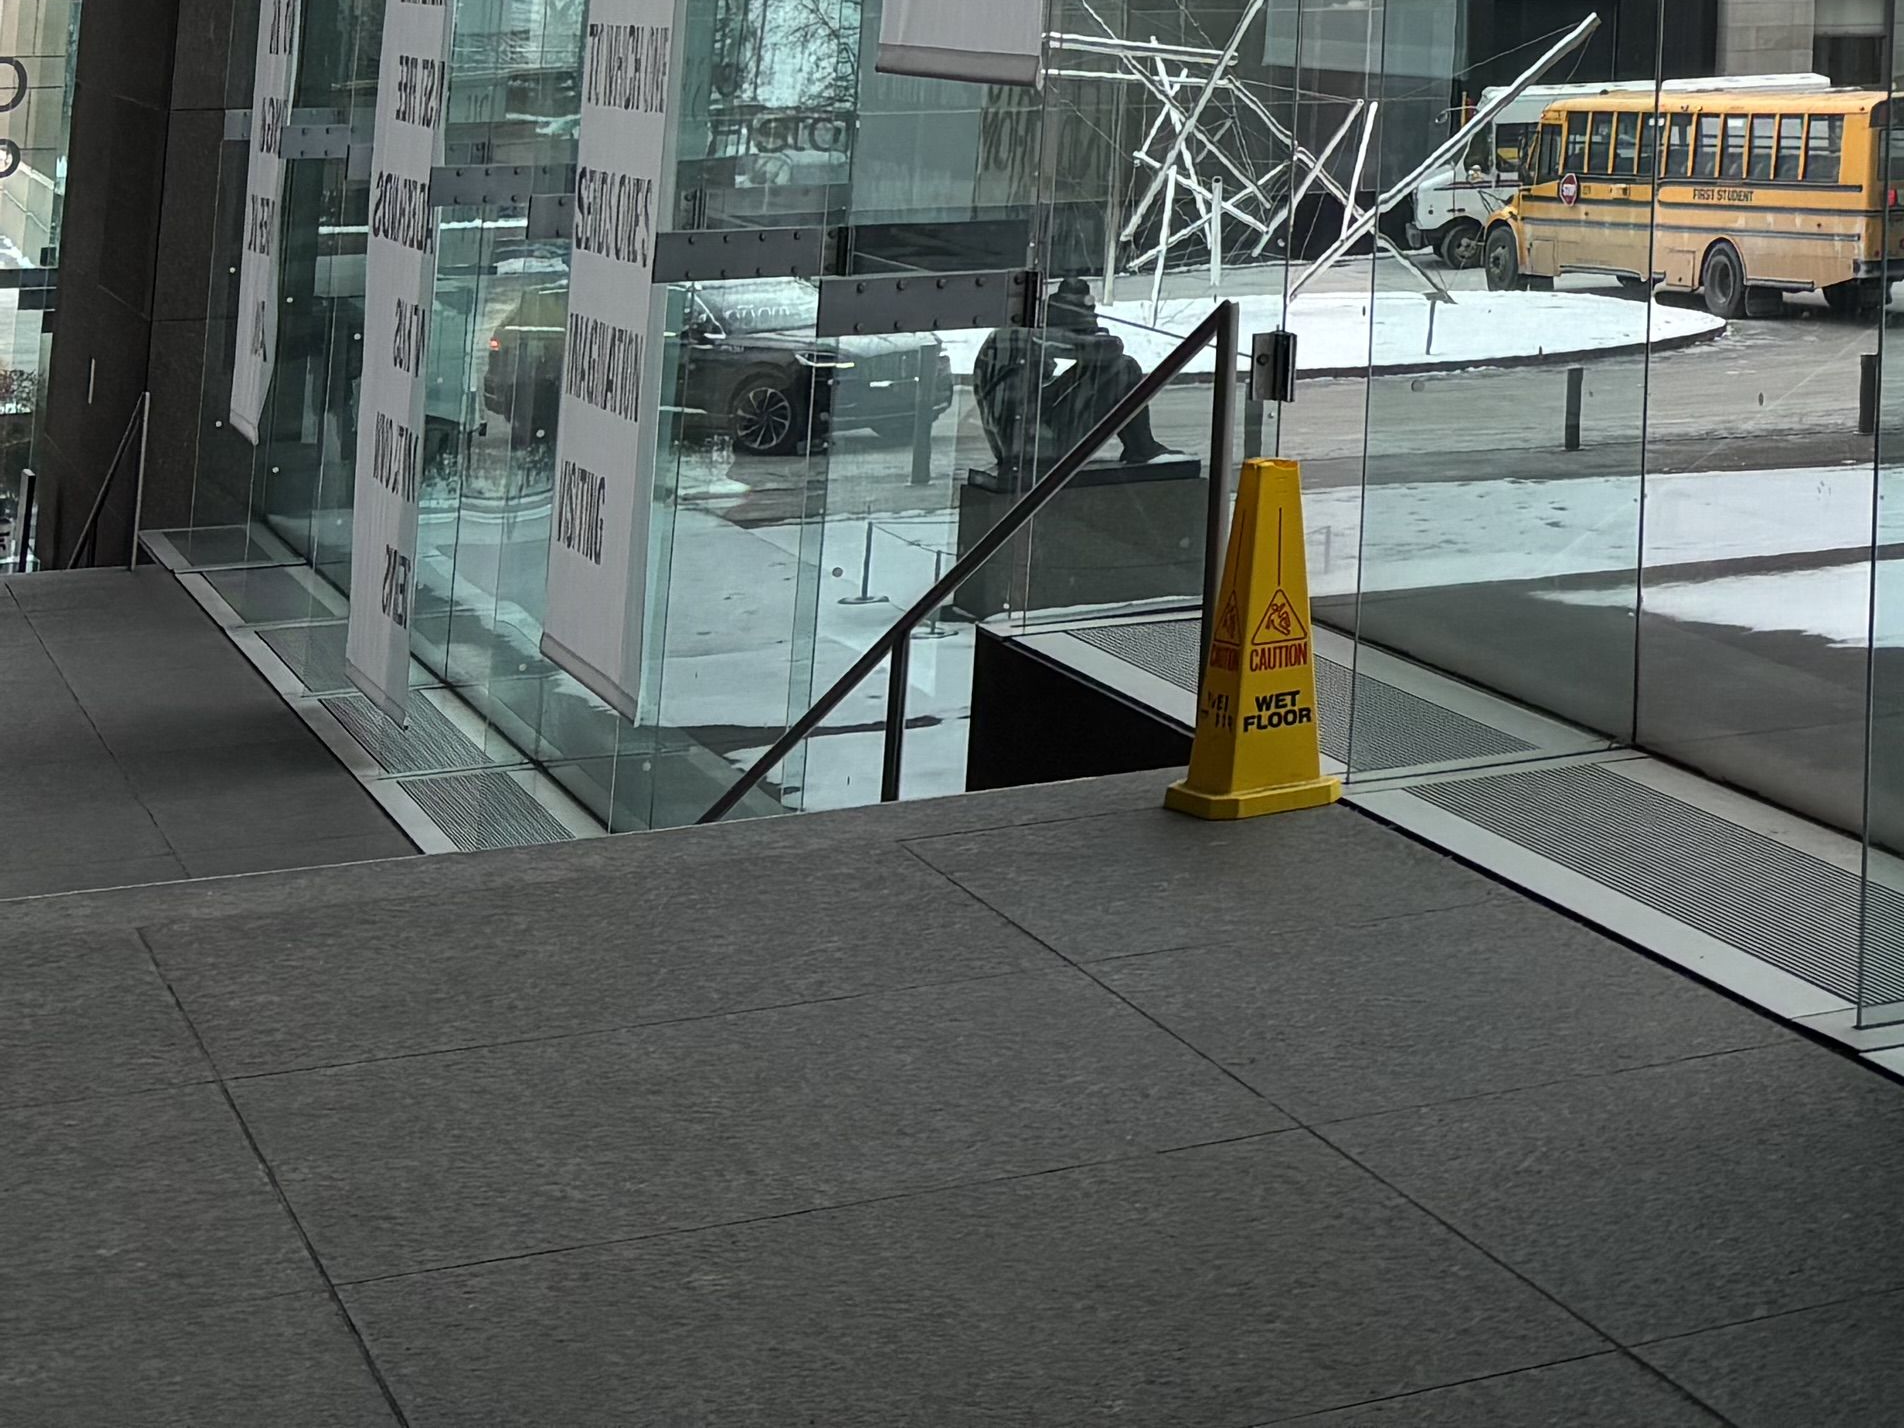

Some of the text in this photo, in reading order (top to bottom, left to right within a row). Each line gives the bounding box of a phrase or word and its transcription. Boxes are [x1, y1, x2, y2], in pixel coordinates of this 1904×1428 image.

[1693, 188, 1754, 201] FIRST STUDENT
[1249, 643, 1308, 672] CAUTION
[1255, 689, 1301, 712] WET
[1243, 706, 1312, 733] FLOOR
